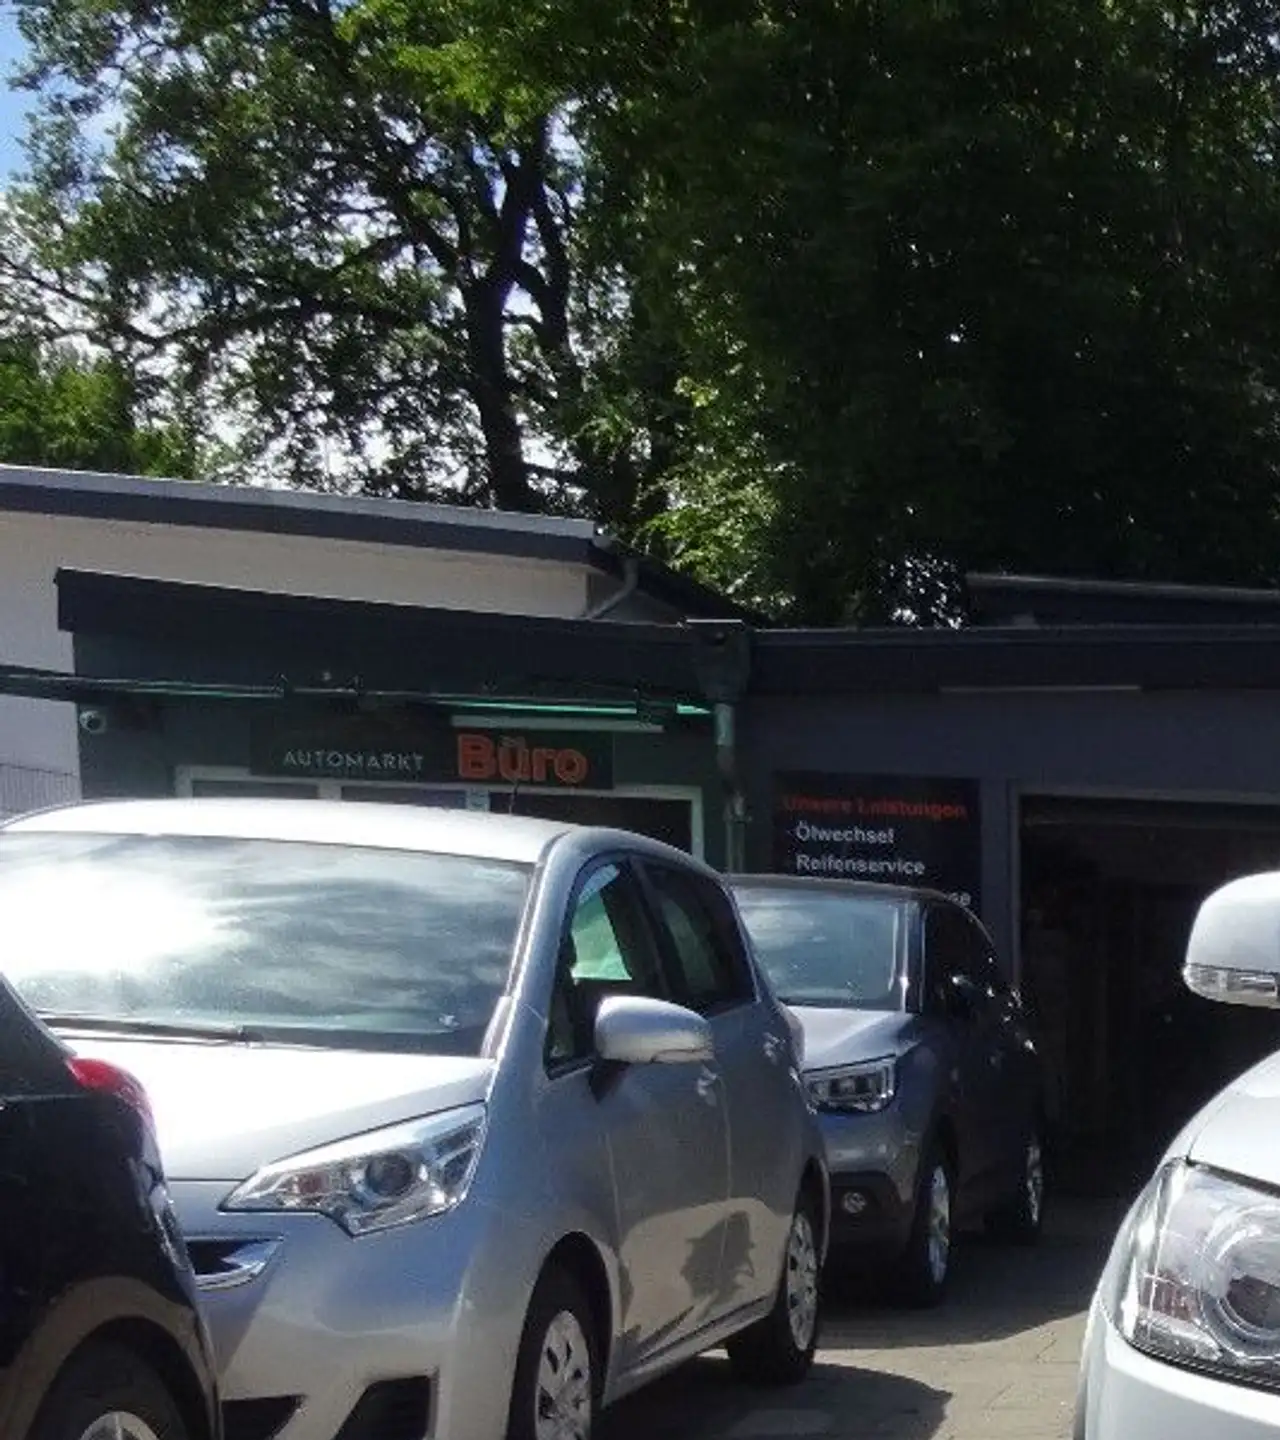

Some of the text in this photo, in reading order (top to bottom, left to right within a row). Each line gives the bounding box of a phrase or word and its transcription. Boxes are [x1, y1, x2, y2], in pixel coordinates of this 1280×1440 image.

[283, 750, 423, 771] AUTOMARKT
[457, 734, 587, 783] Büro
[858, 798, 967, 818] Leistungen
[796, 820, 894, 844] Ölwechsel
[796, 854, 925, 875] Reifenservice
